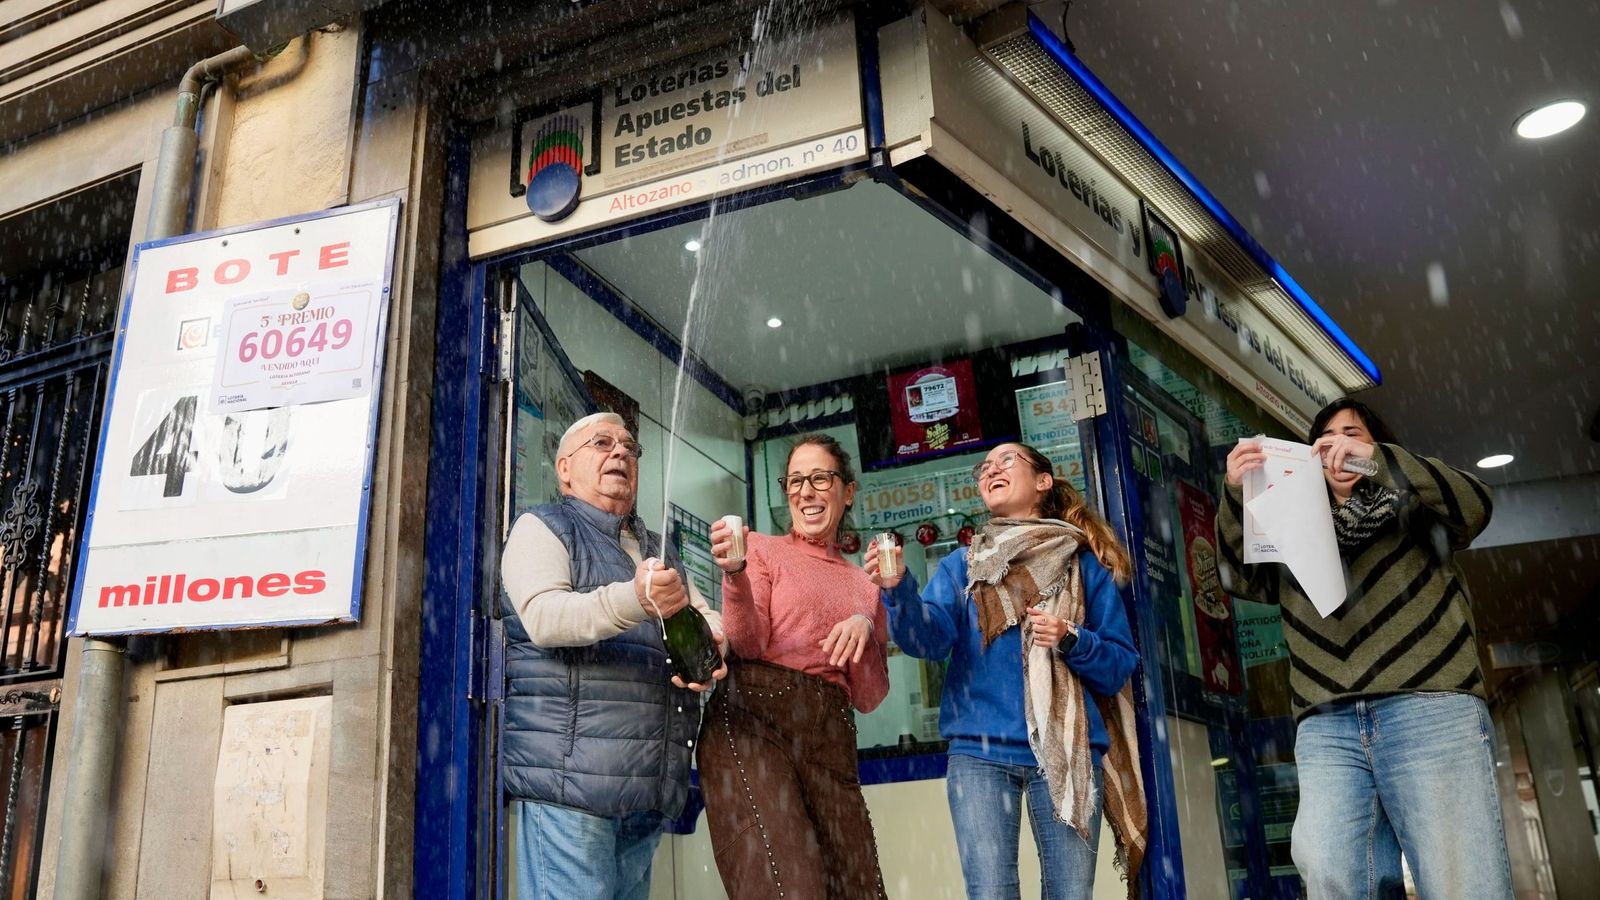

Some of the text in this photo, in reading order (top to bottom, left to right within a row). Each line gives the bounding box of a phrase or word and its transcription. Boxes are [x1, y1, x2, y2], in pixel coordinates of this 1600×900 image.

[614, 57, 730, 107] Loterías
[614, 63, 801, 138] Apuestas del
[614, 125, 712, 168] Estado
[608, 179, 693, 214] Altozano
[719, 154, 794, 186] admon.
[832, 135, 858, 156] 40
[165, 241, 351, 294] BOTE
[277, 306, 335, 327] PREMIO
[238, 319, 353, 363] 60649
[1263, 335, 1286, 376] del
[261, 360, 298, 372] VENDIDO
[1029, 428, 1076, 442] VENDIDO
[1051, 453, 1076, 464] GRAN
[865, 482, 935, 512] 10058
[883, 504, 933, 522] Premio
[98, 569, 327, 609] millones
